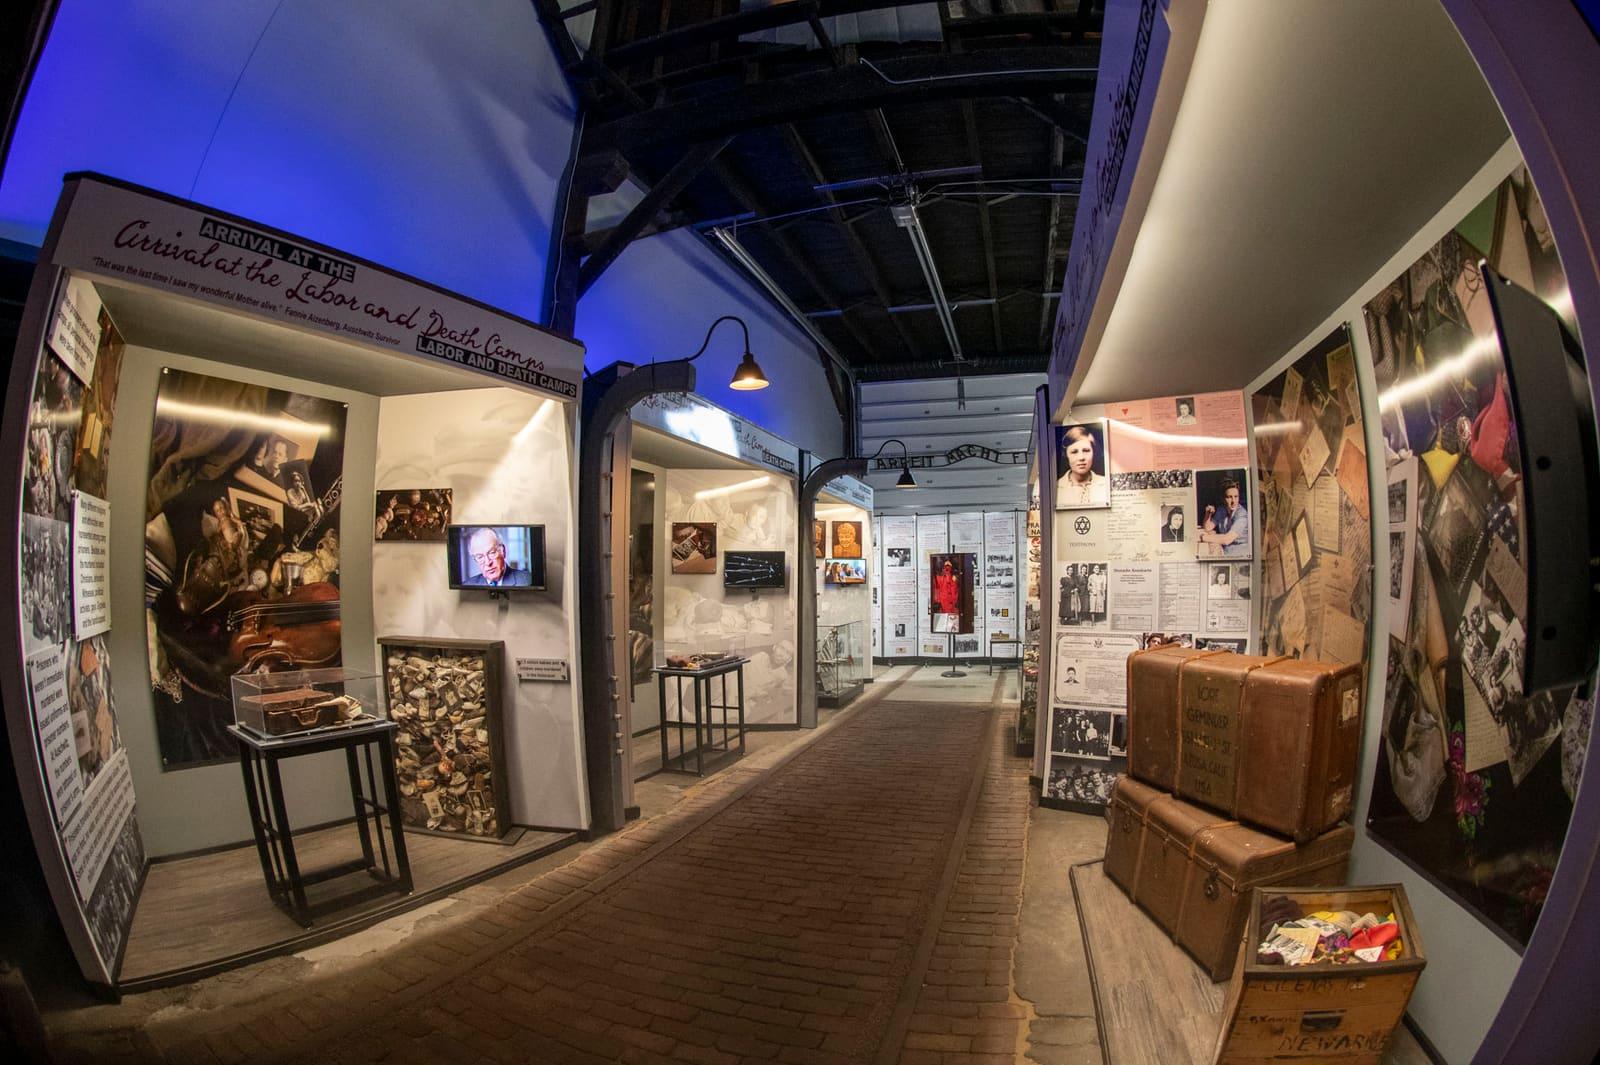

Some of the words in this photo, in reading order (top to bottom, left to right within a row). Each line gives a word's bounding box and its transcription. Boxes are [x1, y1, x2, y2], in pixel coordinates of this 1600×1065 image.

[202, 221, 284, 258] ARRIVAL
[288, 248, 313, 268] AT
[318, 256, 353, 282] THE
[114, 220, 219, 268] Arrival
[215, 257, 243, 276] at
[246, 258, 282, 288] the
[285, 271, 360, 311] Labor
[364, 303, 420, 329] and
[421, 309, 482, 349] Death
[485, 333, 544, 371] Camps
[200, 284, 236, 300] wonderful
[417, 338, 465, 363] LABOR
[467, 354, 496, 371] AND
[498, 362, 537, 385] DEATH
[540, 374, 576, 396] CAMPS
[947, 445, 999, 464] MACHT
